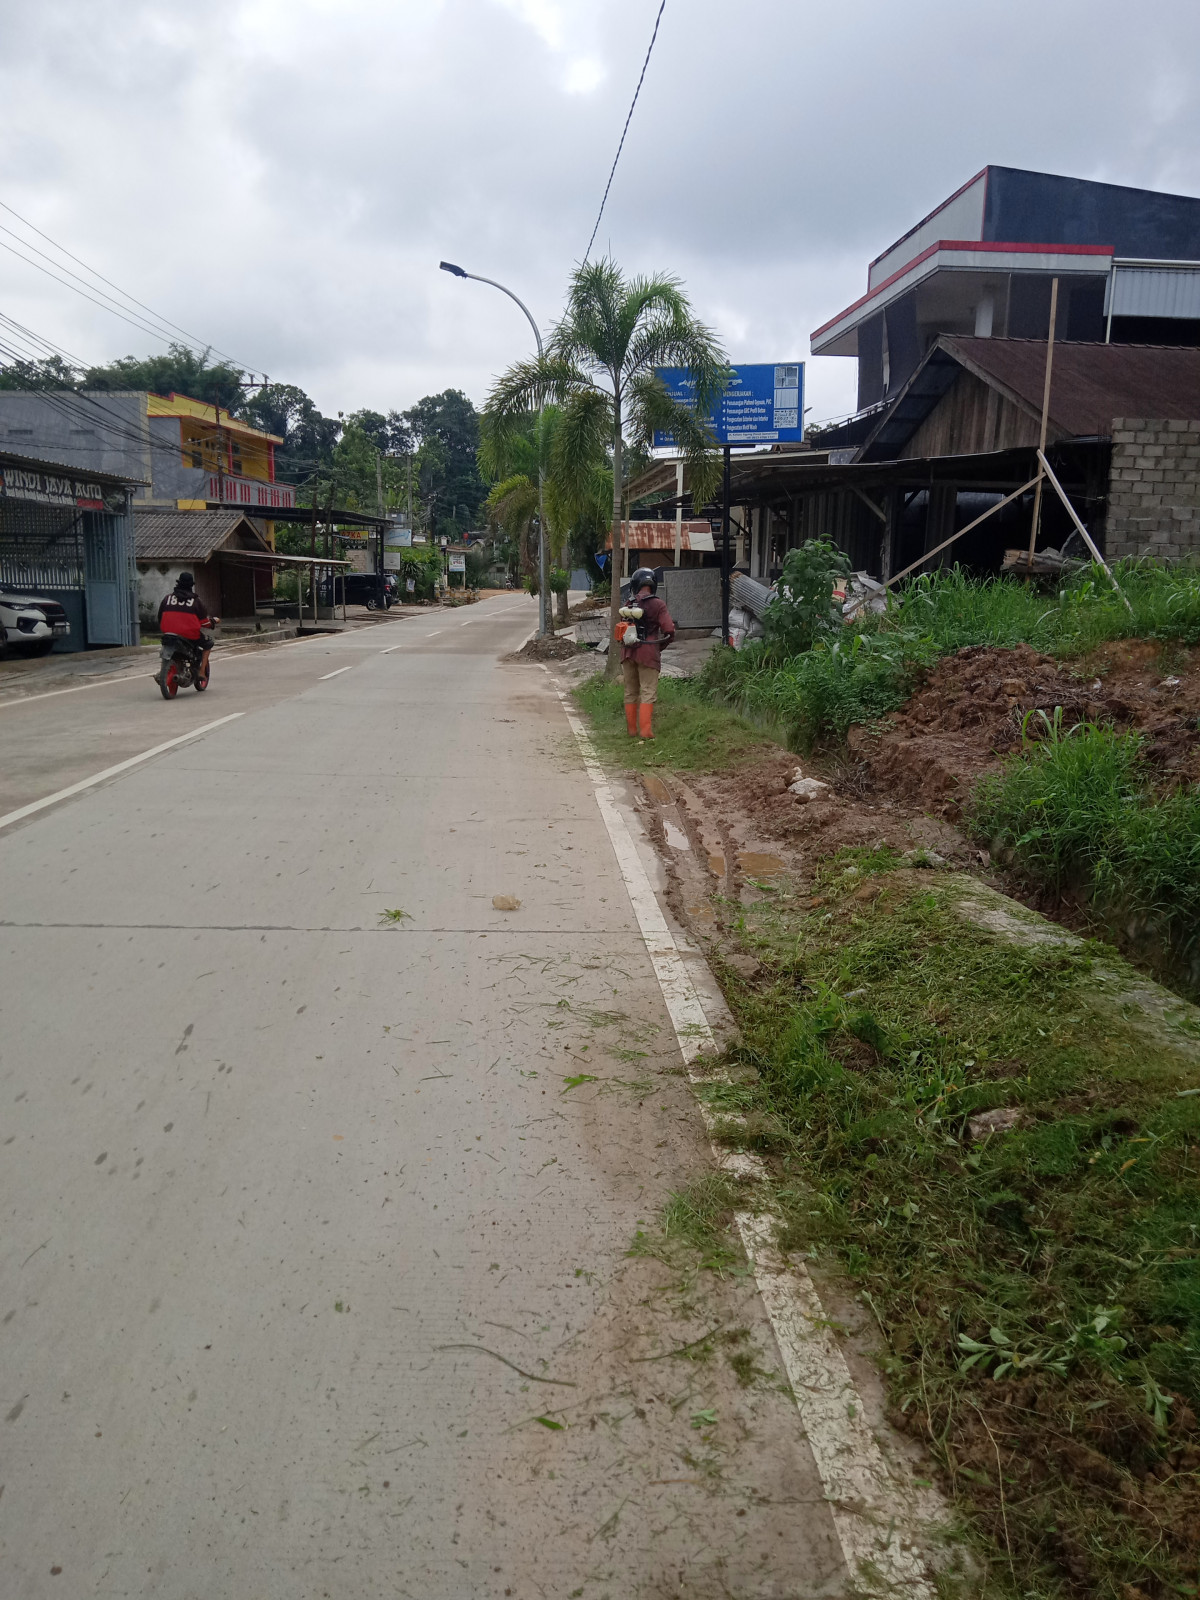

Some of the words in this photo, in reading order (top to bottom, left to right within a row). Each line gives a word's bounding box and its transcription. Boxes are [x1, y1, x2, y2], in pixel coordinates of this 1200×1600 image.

[4, 469, 41, 490] WINDI
[44, 476, 72, 496] JAYA
[75, 482, 102, 499] AUTO
